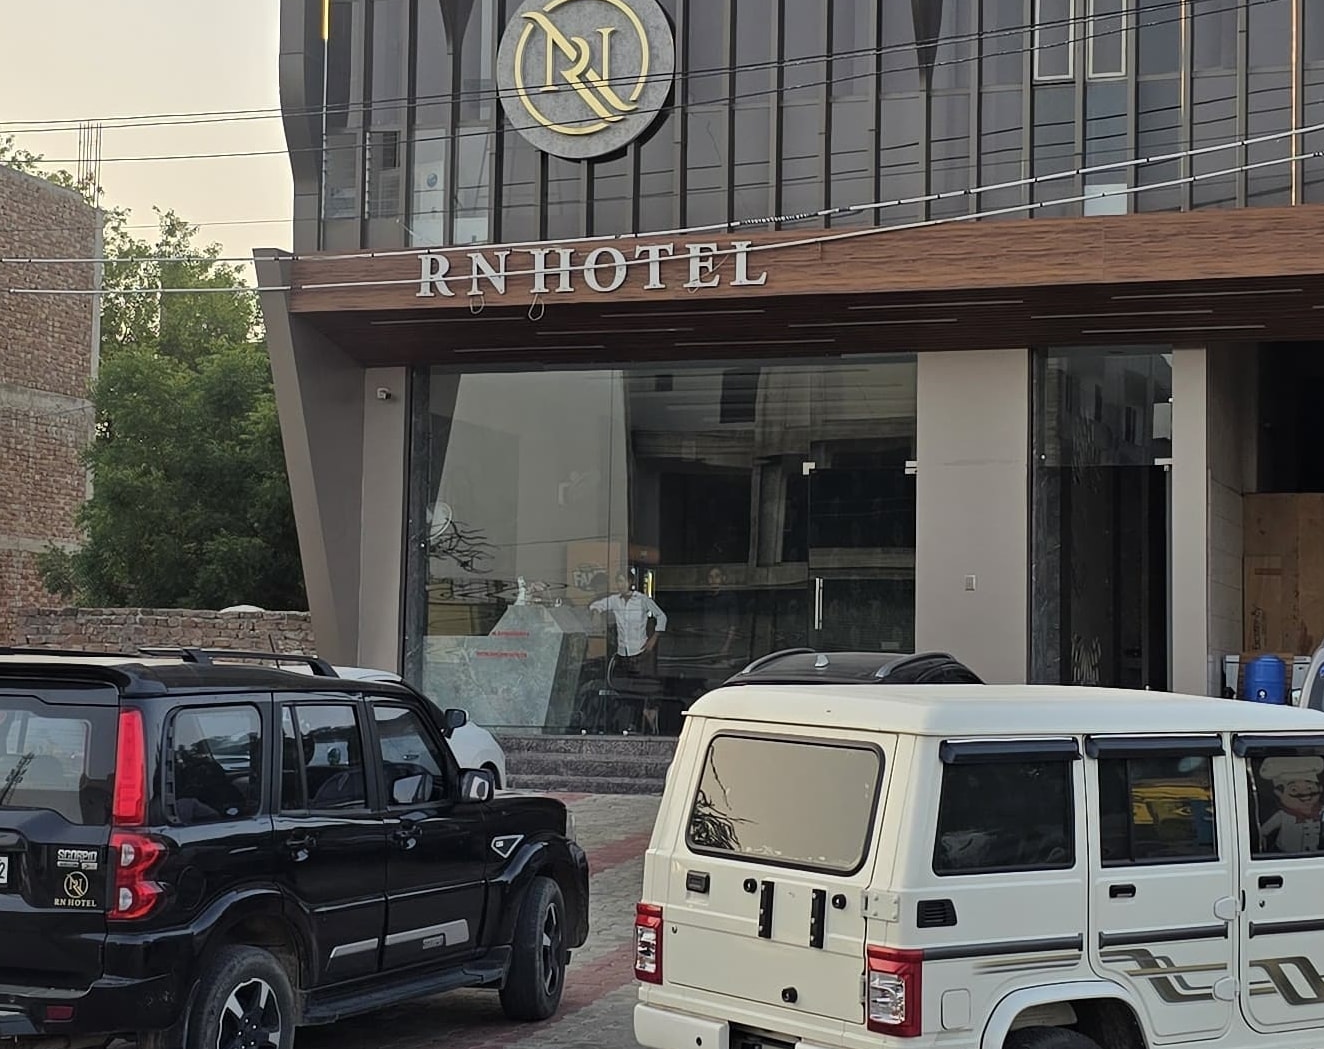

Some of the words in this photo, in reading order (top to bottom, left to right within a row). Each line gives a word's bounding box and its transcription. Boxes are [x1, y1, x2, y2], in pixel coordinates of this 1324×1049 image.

[415, 250, 511, 298] RN
[529, 240, 768, 294] HOTEL
[57, 849, 98, 861] SCORPIO
[54, 898, 67, 906] RN
[68, 898, 97, 908] HOTEL
